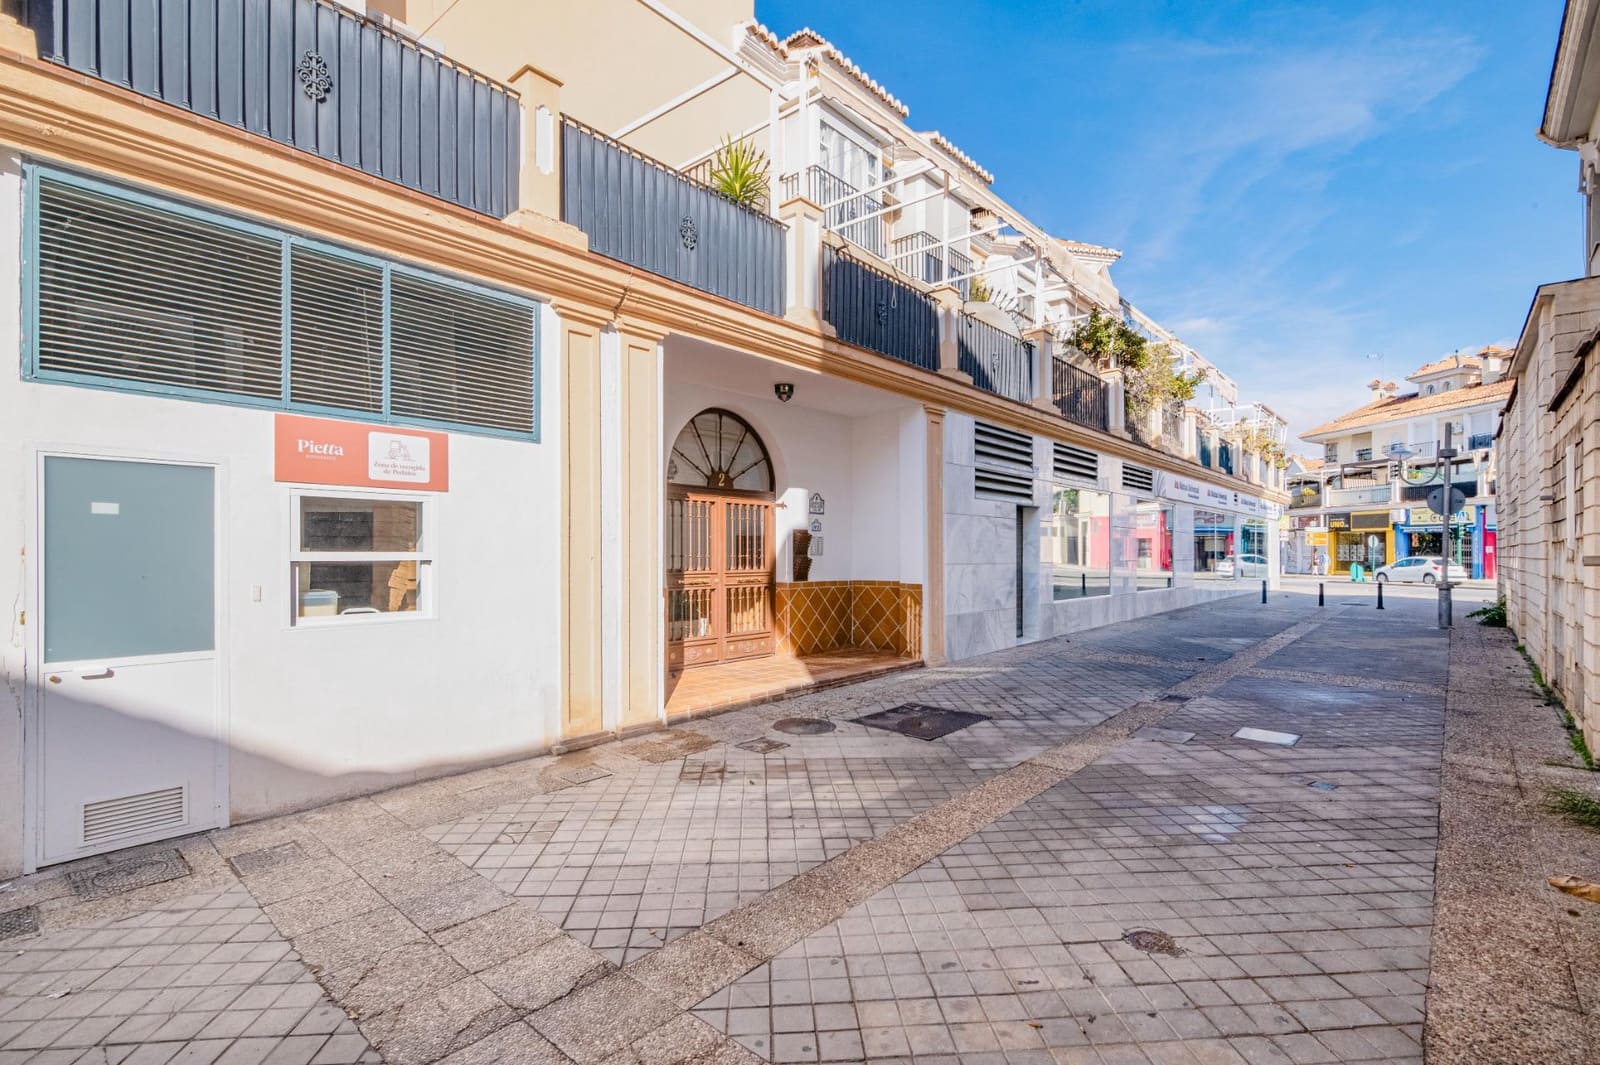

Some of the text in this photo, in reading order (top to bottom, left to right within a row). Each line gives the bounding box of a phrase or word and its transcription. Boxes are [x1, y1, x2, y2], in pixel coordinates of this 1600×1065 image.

[298, 439, 344, 456] Pietta
[719, 473, 725, 486] 2
[1330, 520, 1345, 528] UNO
